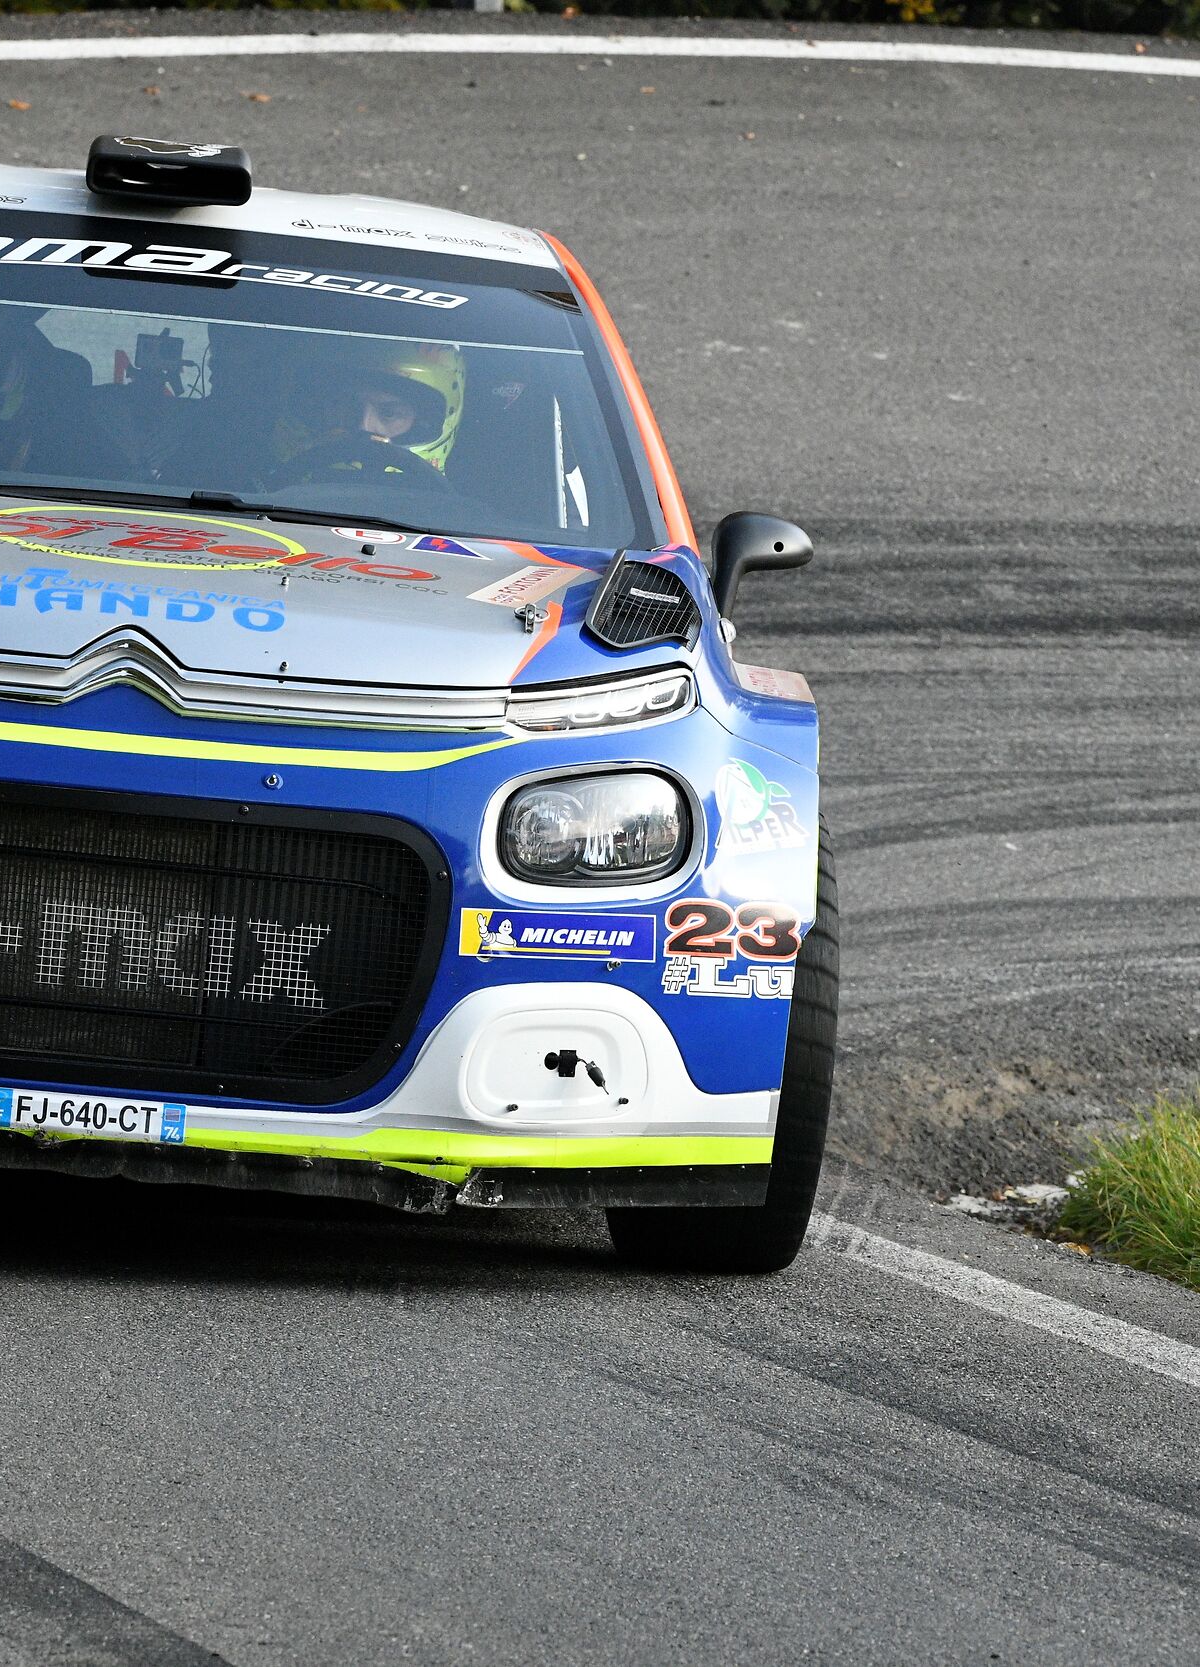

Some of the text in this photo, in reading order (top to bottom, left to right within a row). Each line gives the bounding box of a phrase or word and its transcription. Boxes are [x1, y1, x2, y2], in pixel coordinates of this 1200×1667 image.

[291, 218, 416, 239] d-max
[221, 264, 469, 309] racing
[128, 549, 156, 557] LE
[311, 571, 384, 585] CORSI
[253, 569, 341, 584] CISLAGO
[520, 927, 635, 947] MICHELIN
[665, 899, 800, 962] 23
[15, 1094, 158, 1134] FJ-640-CT
[163, 1126, 181, 1142] 74
